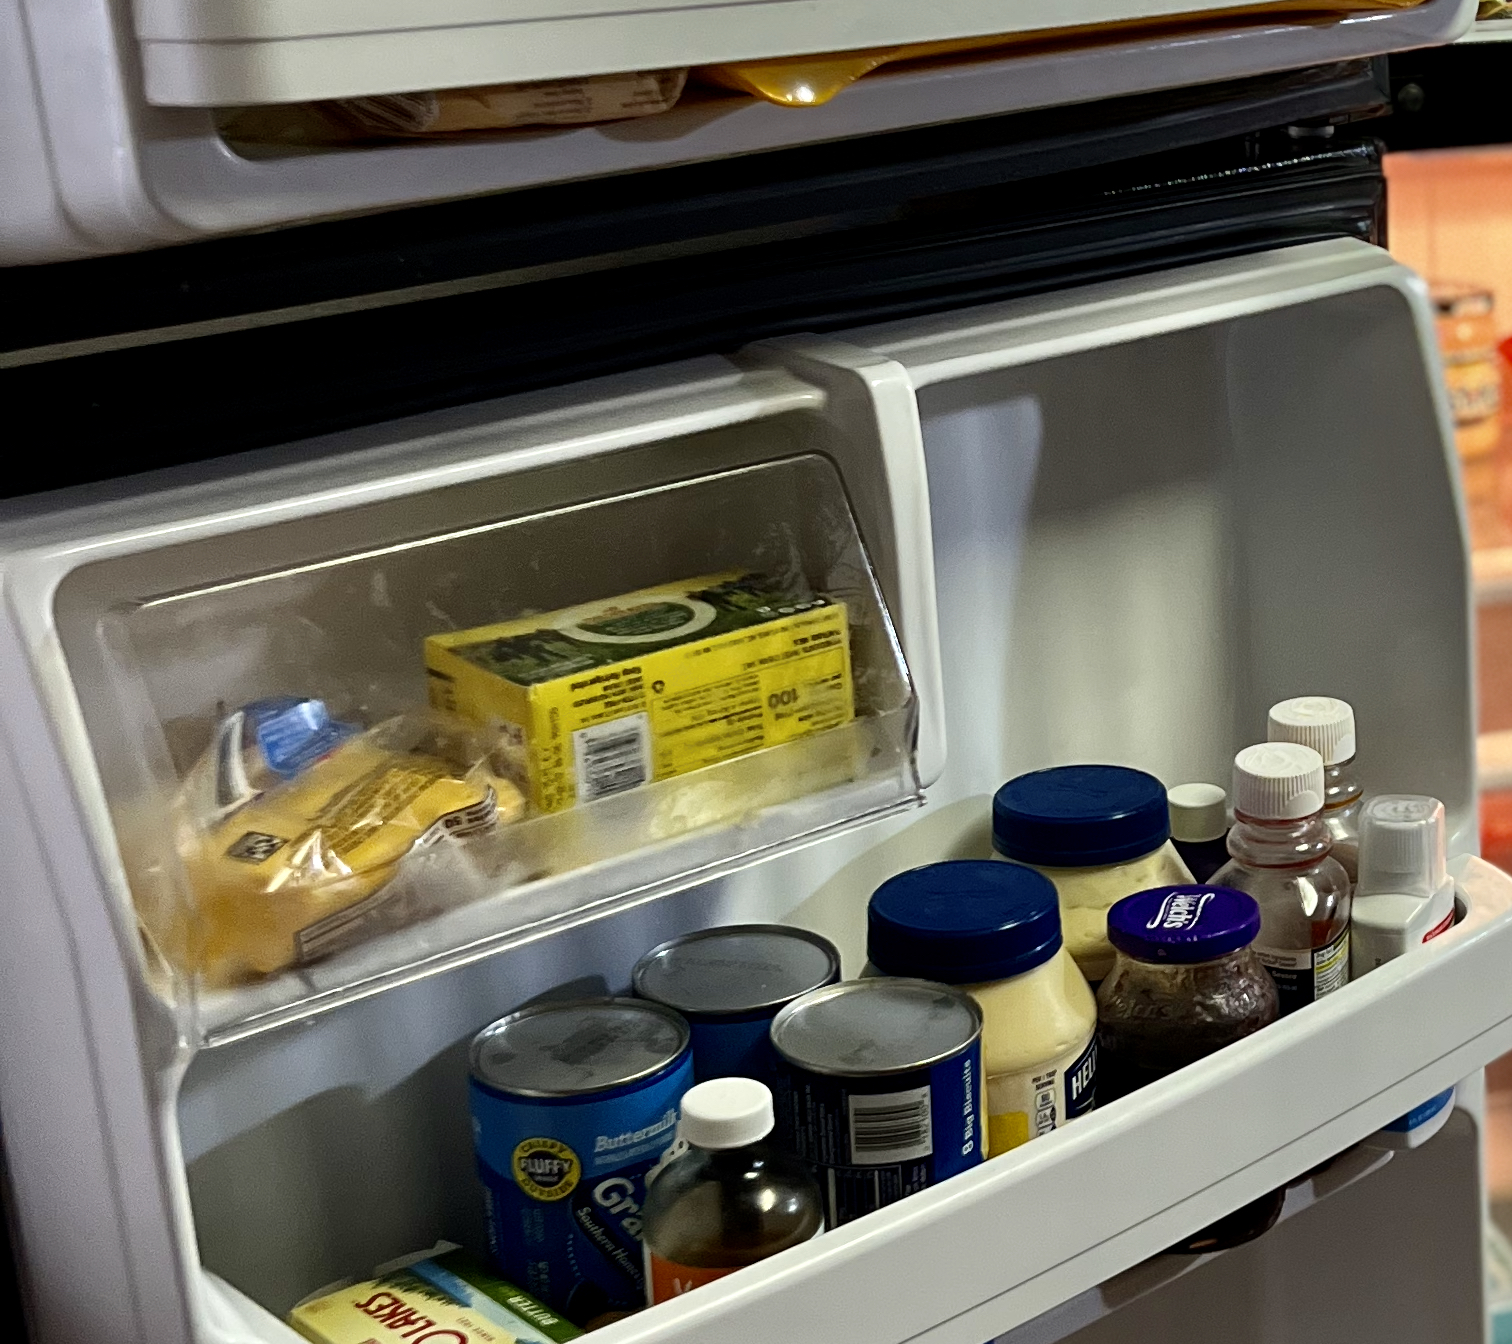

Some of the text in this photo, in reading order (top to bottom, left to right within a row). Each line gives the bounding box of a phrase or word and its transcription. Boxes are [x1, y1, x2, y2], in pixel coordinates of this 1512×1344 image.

[768, 687, 799, 709] 100
[1071, 1042, 1098, 1101] HELL
[594, 1107, 678, 1153] Buttermilk
[962, 1058, 975, 1155] 8 Big Biscuits
[519, 1157, 572, 1174] FLUFFY
[577, 1206, 616, 1253] Southern
[592, 1177, 645, 1242] Gra
[355, 1291, 438, 1339] LAKES
[507, 1294, 559, 1327] BUTTER
